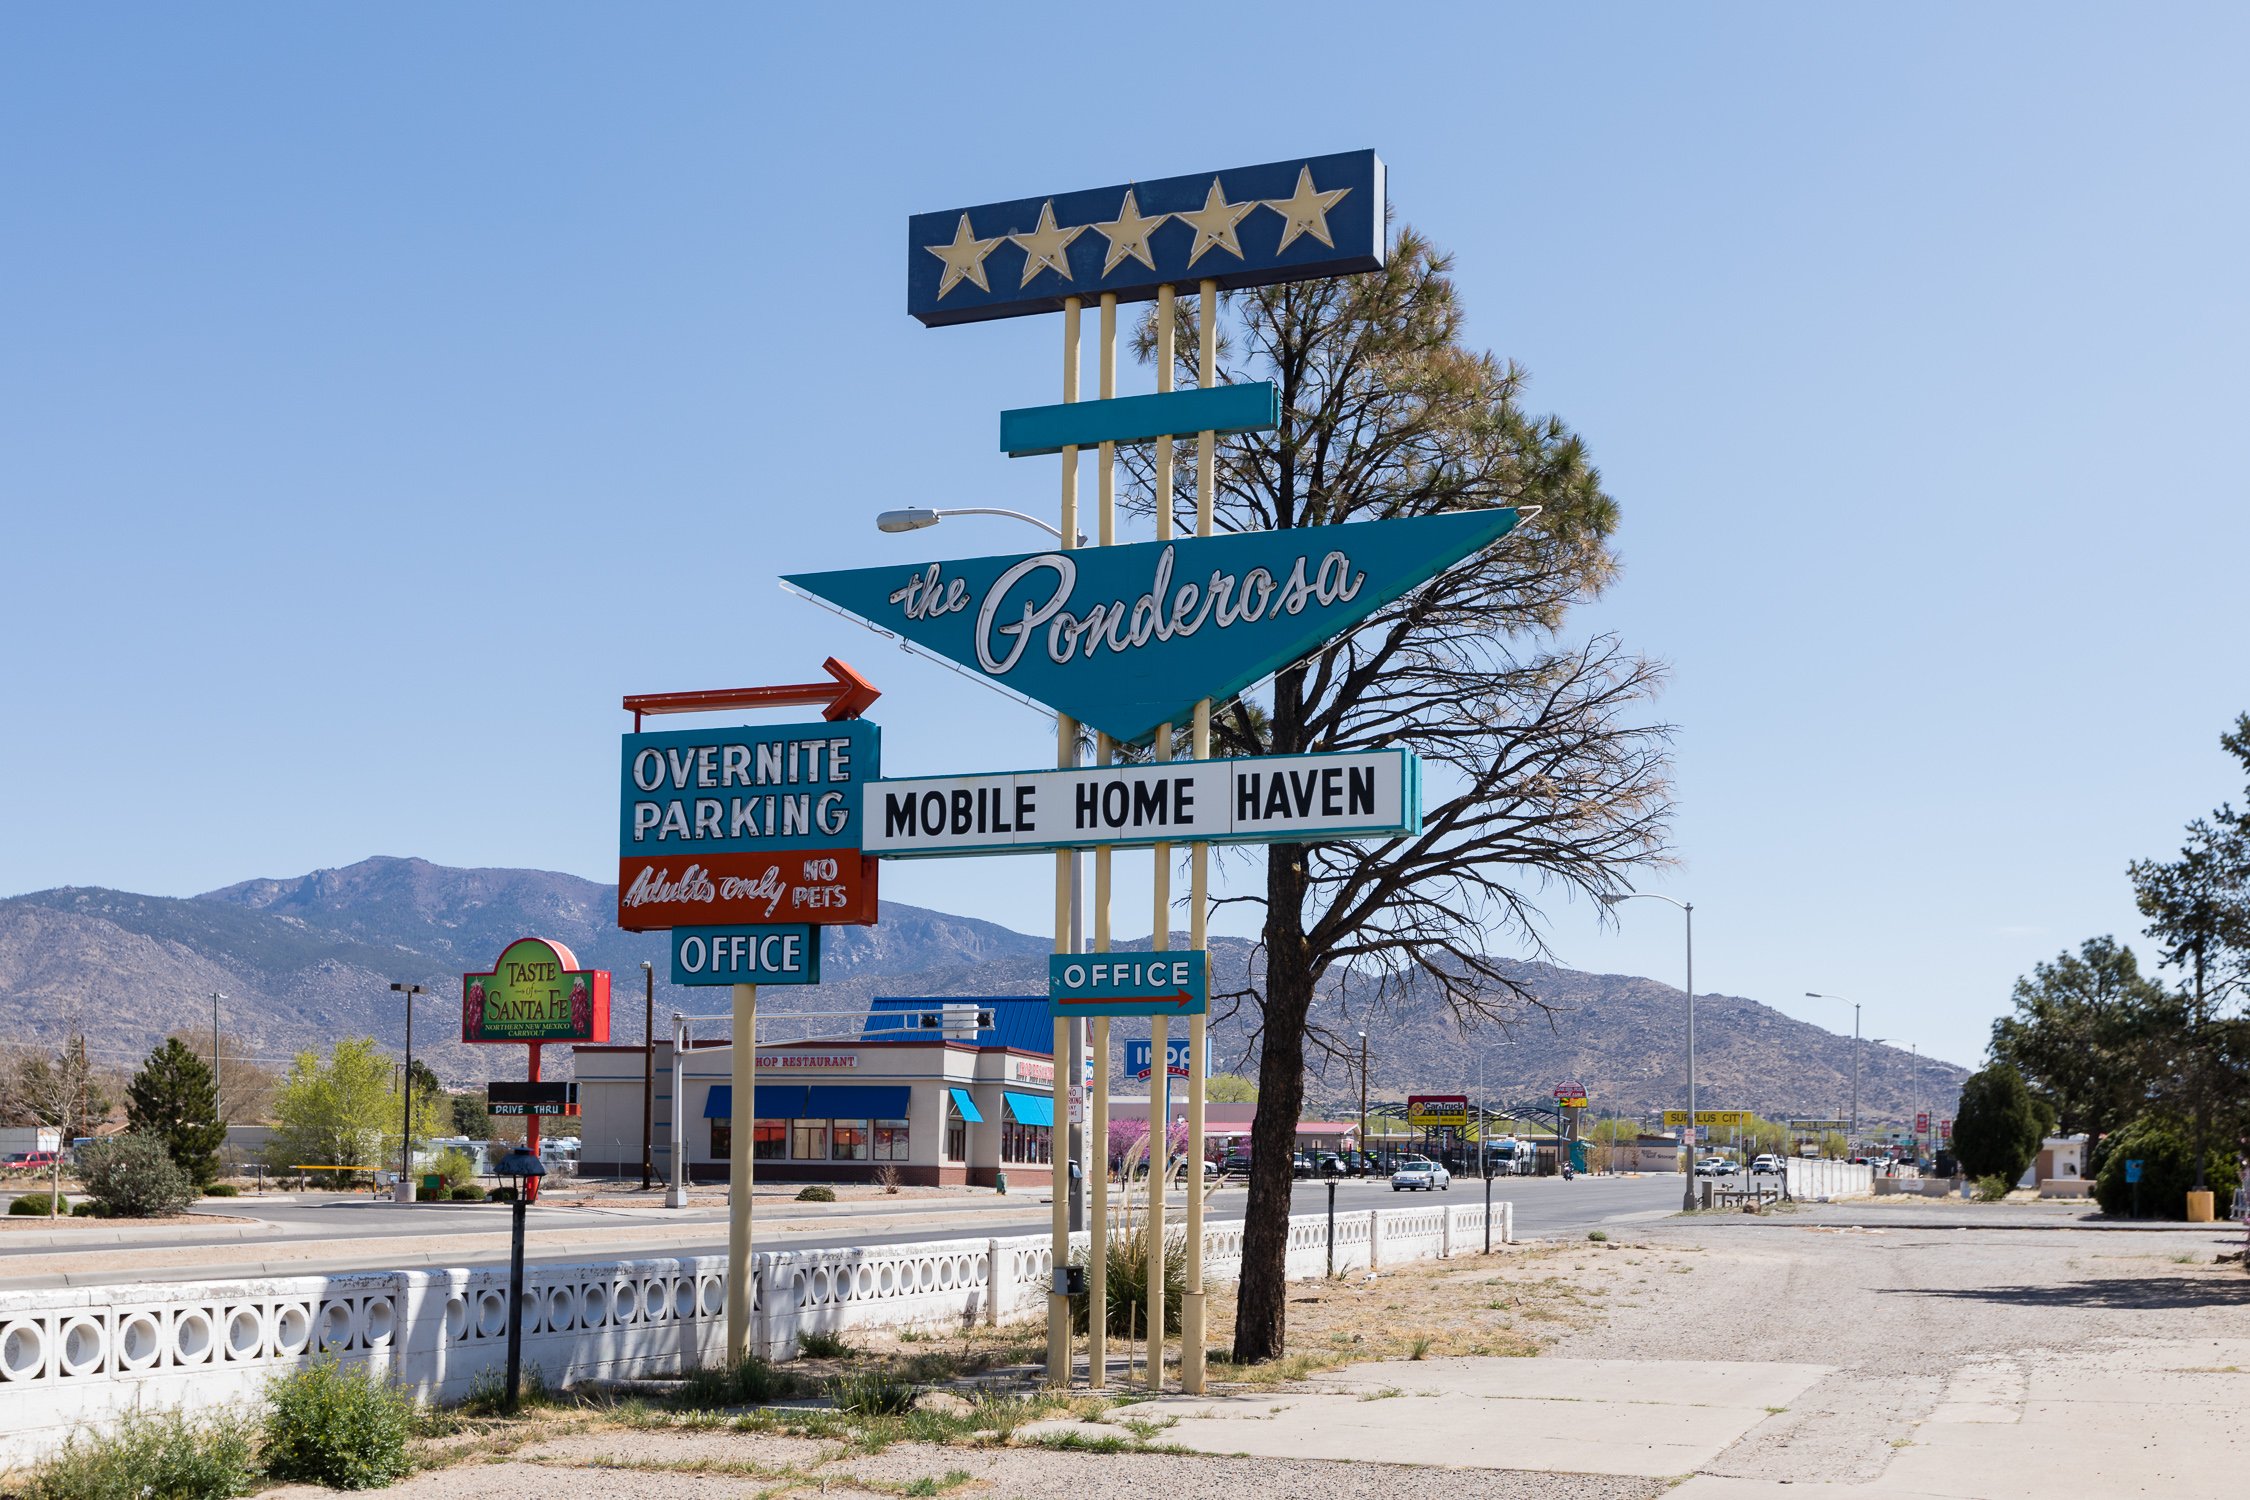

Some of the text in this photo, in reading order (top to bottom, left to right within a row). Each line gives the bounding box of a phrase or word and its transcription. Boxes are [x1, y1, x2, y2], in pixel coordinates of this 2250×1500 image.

[889, 544, 1366, 675] the Ponderosa
[633, 738, 850, 791] OVERNITE
[885, 766, 1375, 838] MOBILE HOME HAVEN
[634, 793, 849, 841] PARKING
[804, 858, 838, 881] NO
[622, 865, 787, 918] Adults only
[792, 886, 847, 909] PETS
[680, 934, 801, 972] OFFICE
[505, 962, 556, 987] TASTE
[1063, 962, 1189, 988] OFFICE
[488, 991, 546, 1020] SANTA
[781, 1056, 855, 1067] RESTAURANT
[495, 1105, 559, 1114] DRIVE THRU
